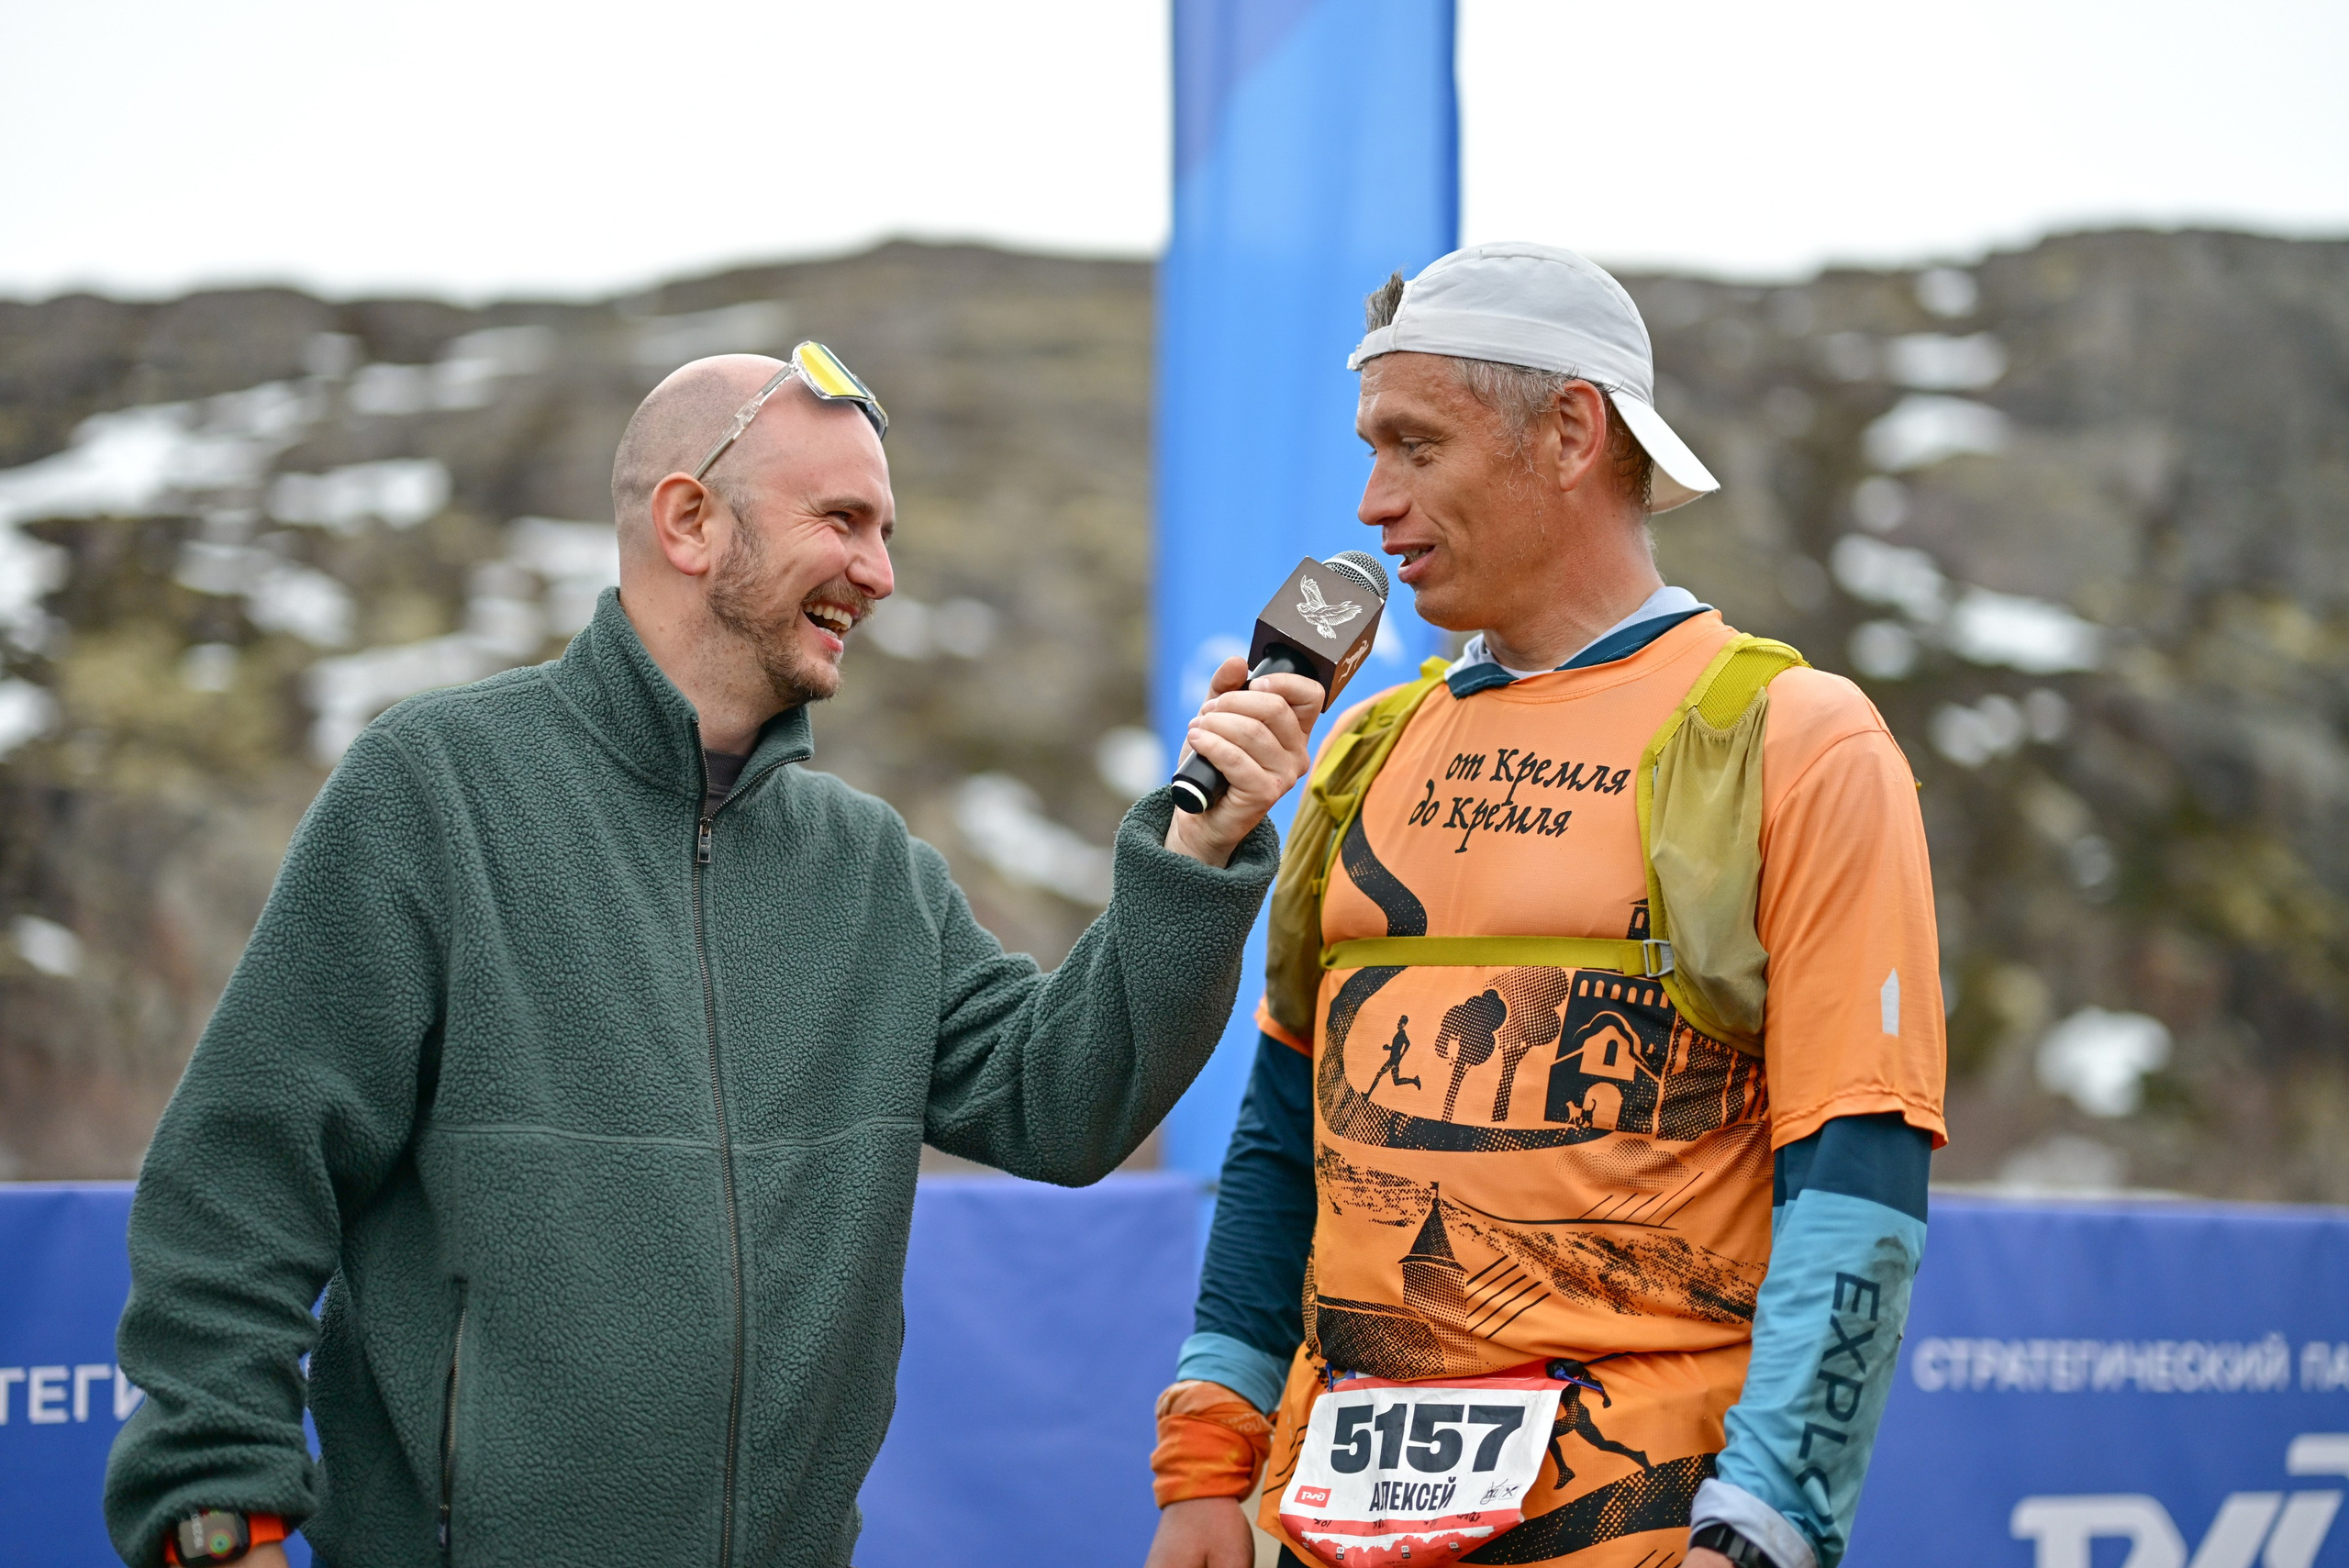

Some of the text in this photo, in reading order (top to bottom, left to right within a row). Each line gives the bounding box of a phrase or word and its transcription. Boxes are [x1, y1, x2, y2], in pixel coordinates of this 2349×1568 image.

[1445, 748, 1631, 806] от Кремля
[1408, 779, 1572, 853] до Кремля
[1330, 1403, 1525, 1473] 5157
[1369, 1476, 1456, 1512] АЛЕКСЕЙ
